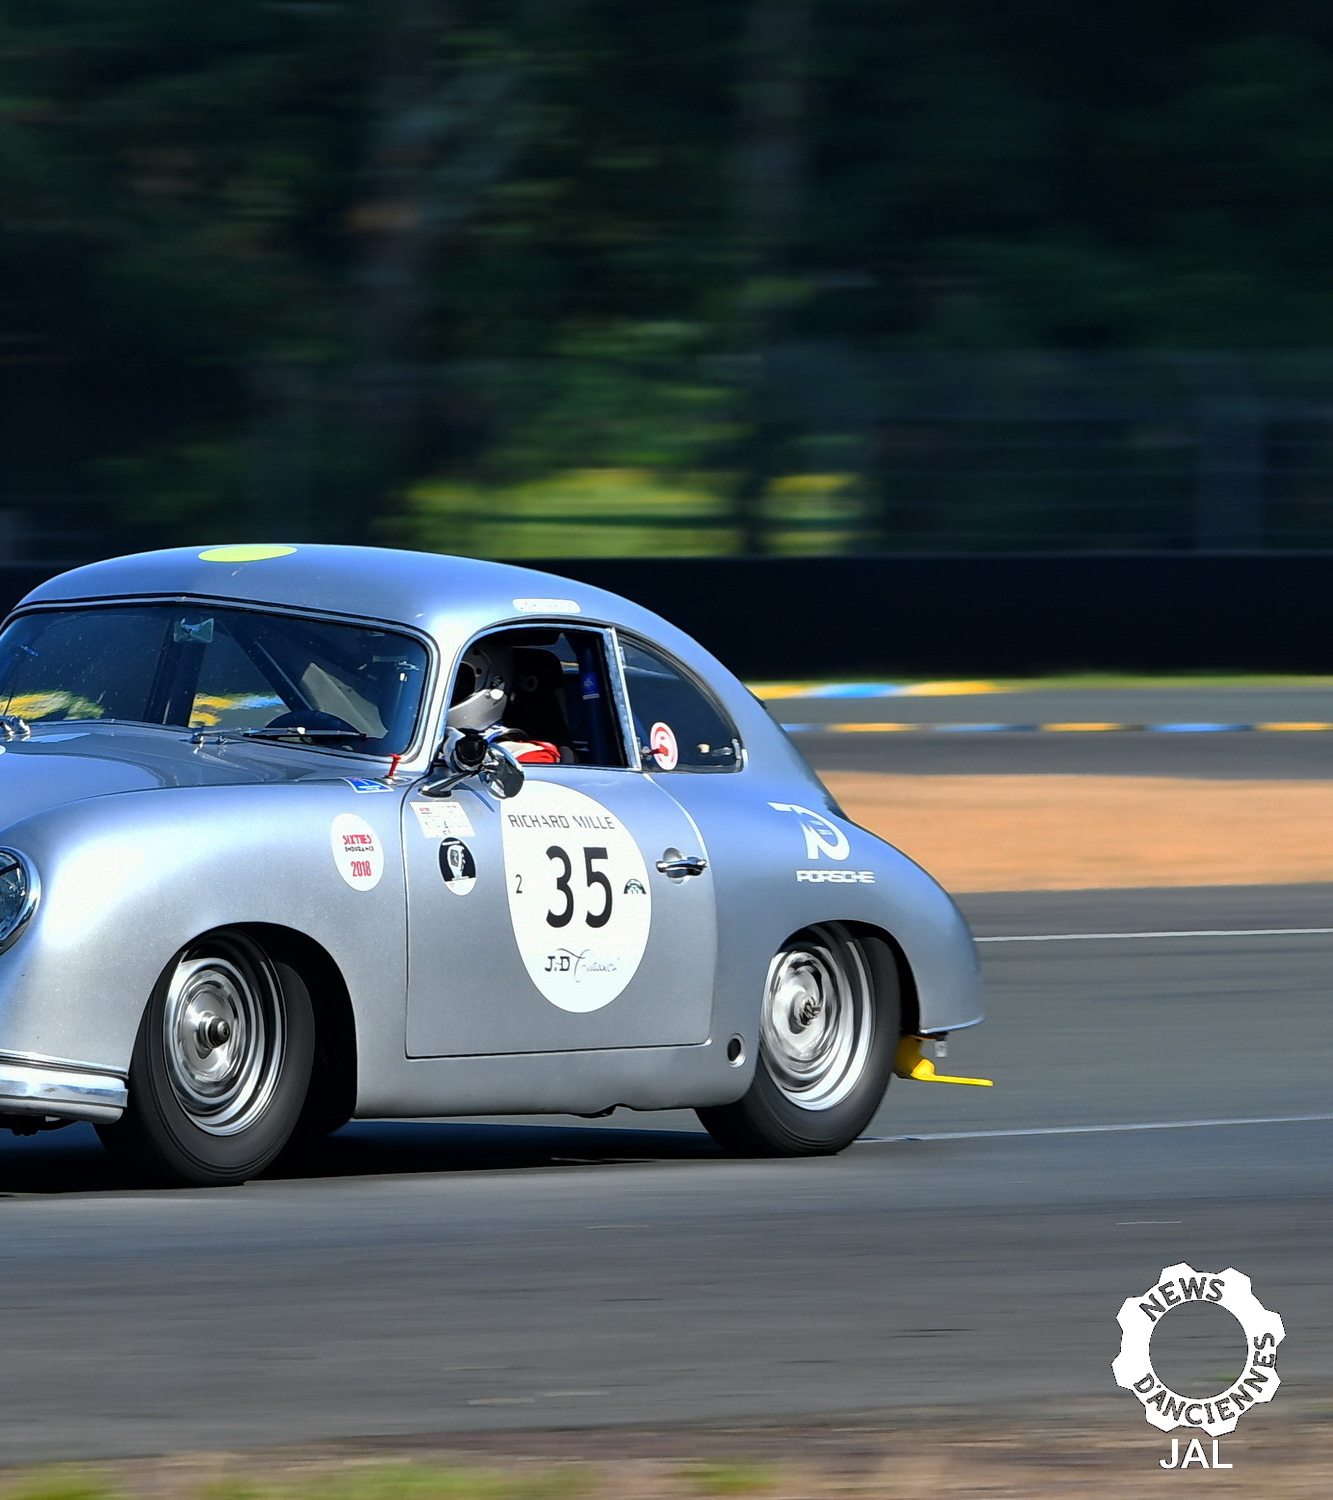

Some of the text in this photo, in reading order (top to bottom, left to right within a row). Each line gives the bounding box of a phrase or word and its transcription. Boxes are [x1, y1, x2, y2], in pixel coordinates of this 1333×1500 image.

[507, 814, 615, 830] RICHARD MILLE
[350, 860, 372, 877] 2018
[795, 870, 876, 884] PORSCHE
[514, 873, 523, 894] 2
[545, 845, 613, 929] 35
